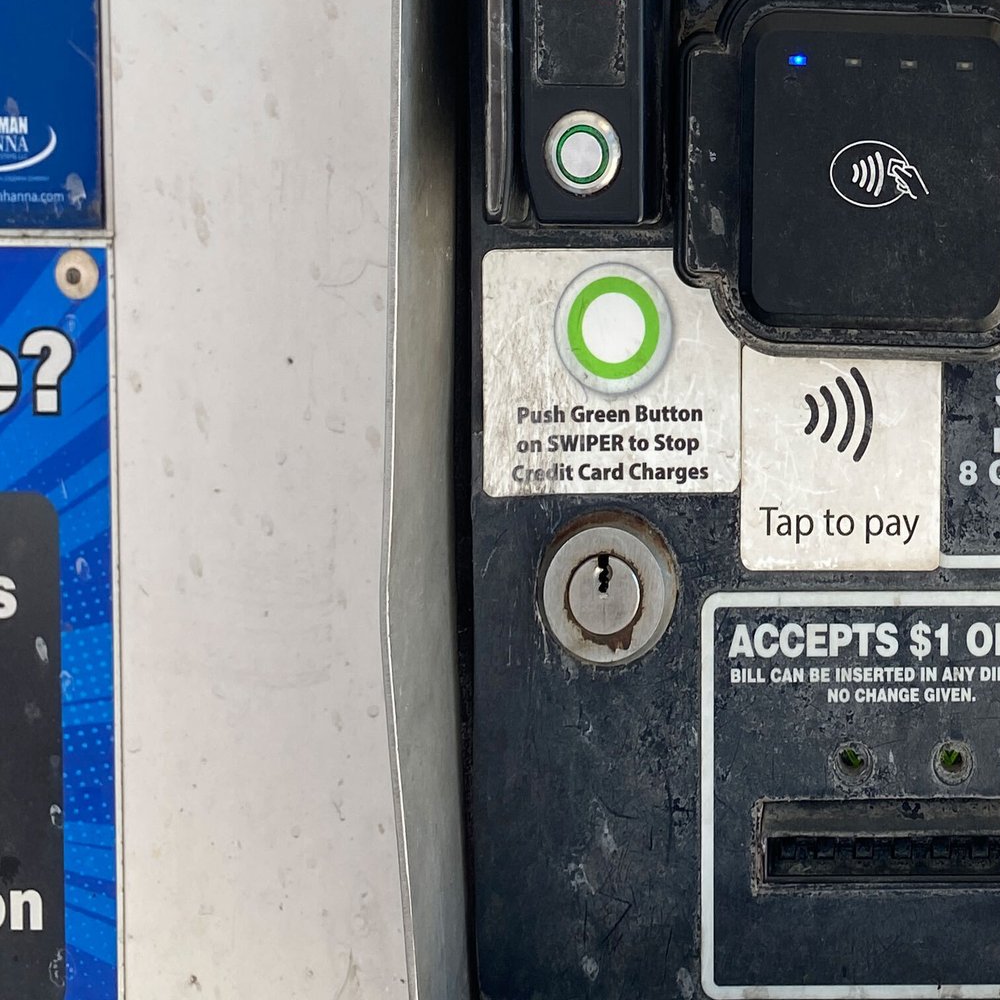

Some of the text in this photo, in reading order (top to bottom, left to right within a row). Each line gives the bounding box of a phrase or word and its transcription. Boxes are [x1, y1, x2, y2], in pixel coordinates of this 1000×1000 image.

[0, 189, 65, 202] hanna.com
[517, 405, 703, 423] Push Green Button
[516, 434, 700, 455] on SWIPER to Stop
[511, 463, 709, 485] Credit Card Charges
[959, 460, 978, 486] 8
[759, 507, 920, 545] Tap to pay
[728, 623, 898, 658] ACCEPTS
[910, 621, 950, 660] $1
[730, 669, 765, 683] BILL
[770, 668, 804, 683] CAN
[809, 668, 830, 682] BE
[835, 668, 915, 682] INSERTED
[920, 667, 937, 682] IN
[941, 667, 975, 682] ANY
[827, 688, 976, 703] NO CHANGE GIVEN.
